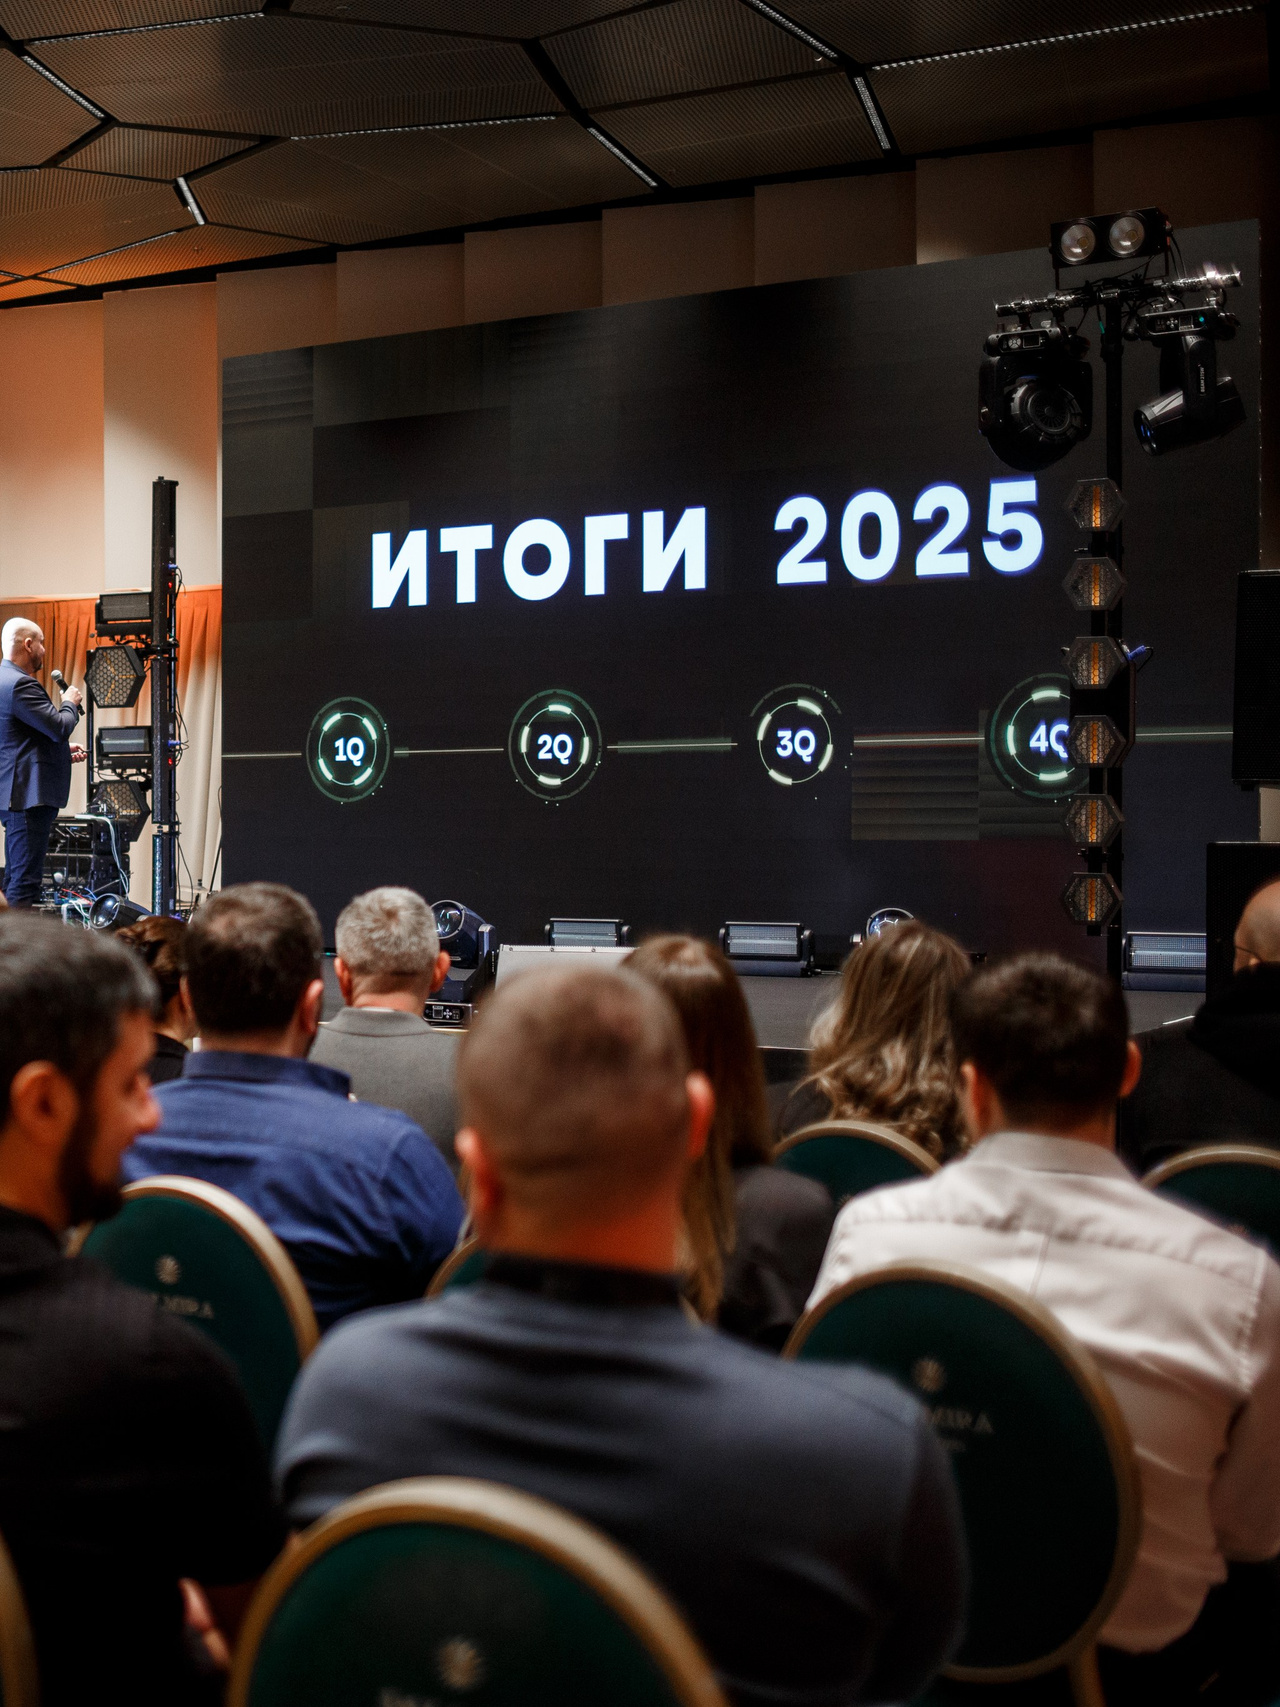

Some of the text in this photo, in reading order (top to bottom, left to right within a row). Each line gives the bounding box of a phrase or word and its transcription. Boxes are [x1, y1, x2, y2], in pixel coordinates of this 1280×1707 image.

[371, 476, 1045, 609] ИТОГИ 2025
[334, 736, 366, 767] 1Q
[537, 733, 574, 765] 2Q
[776, 728, 817, 764] 3Q
[1029, 722, 1070, 759] 4Q
